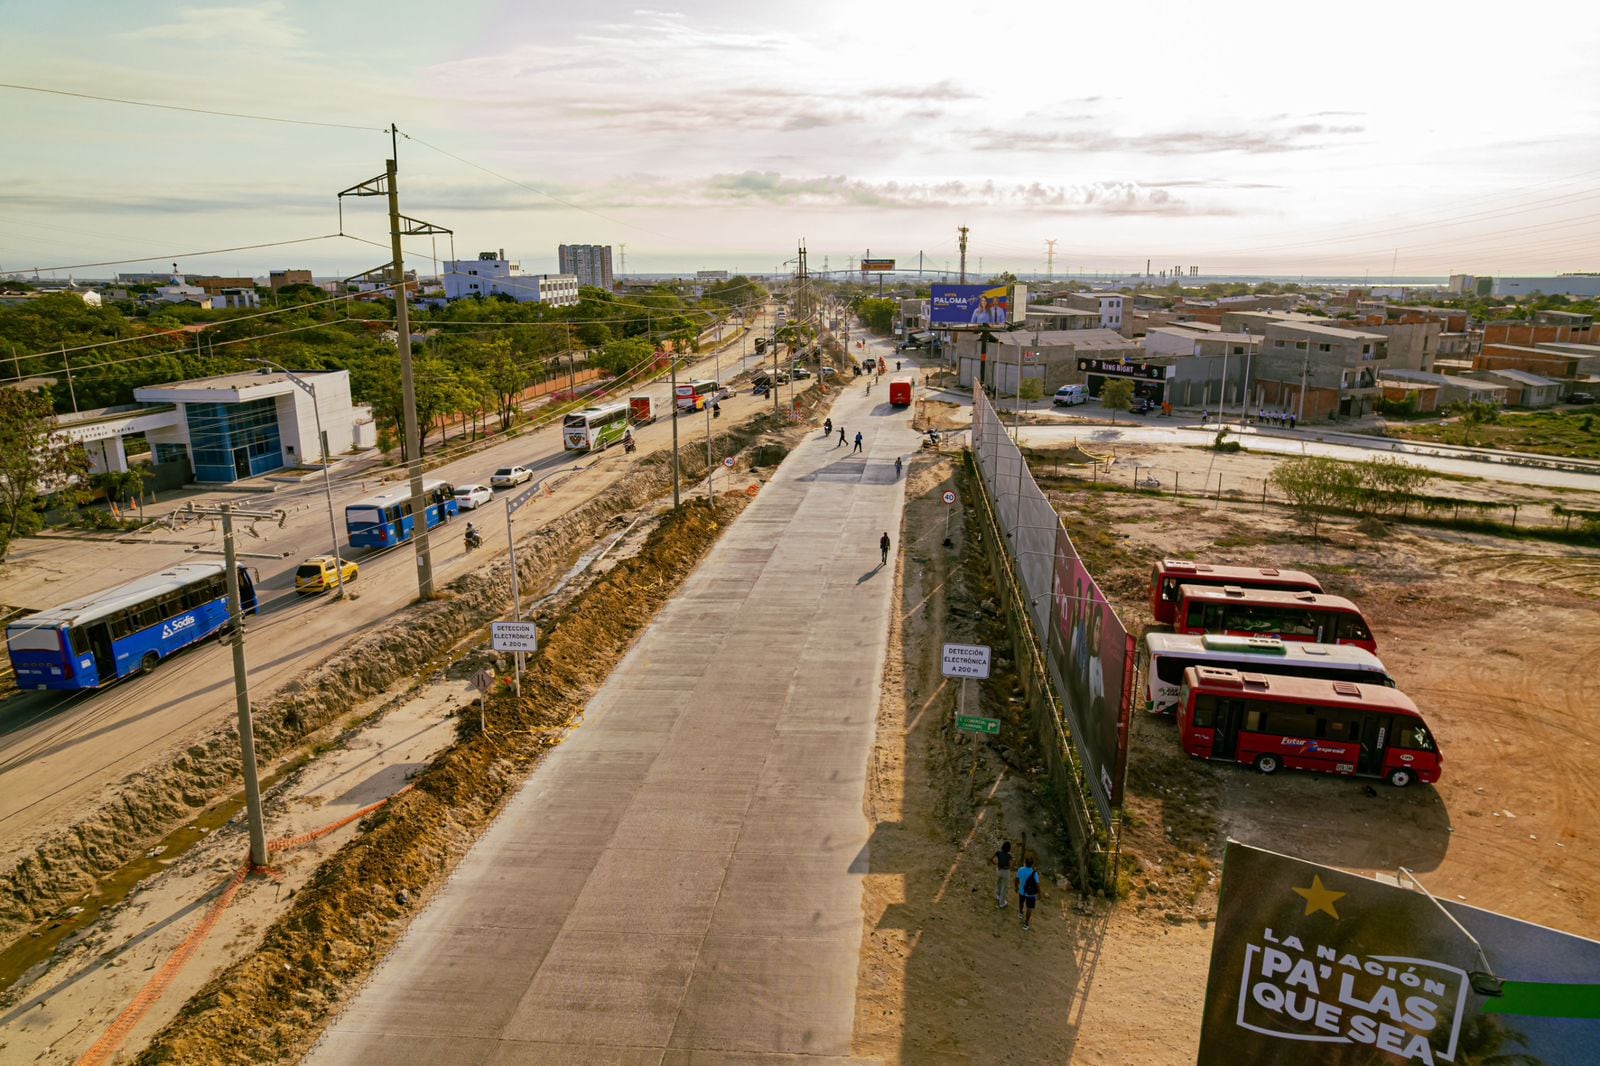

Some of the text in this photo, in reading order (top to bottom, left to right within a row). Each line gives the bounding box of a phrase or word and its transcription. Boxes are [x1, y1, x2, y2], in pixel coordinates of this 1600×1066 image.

[1102, 361, 1116, 370] KING
[171, 615, 195, 630] Sodis
[948, 648, 983, 656] DETECCIÓN
[944, 656, 987, 665] ELECTRÓNICA
[1281, 736, 1307, 746] Futur
[1264, 928, 1446, 997] LA NACIÓN
[1338, 973, 1437, 1031] LAS
[1252, 981, 1435, 1066] QUE SEA
